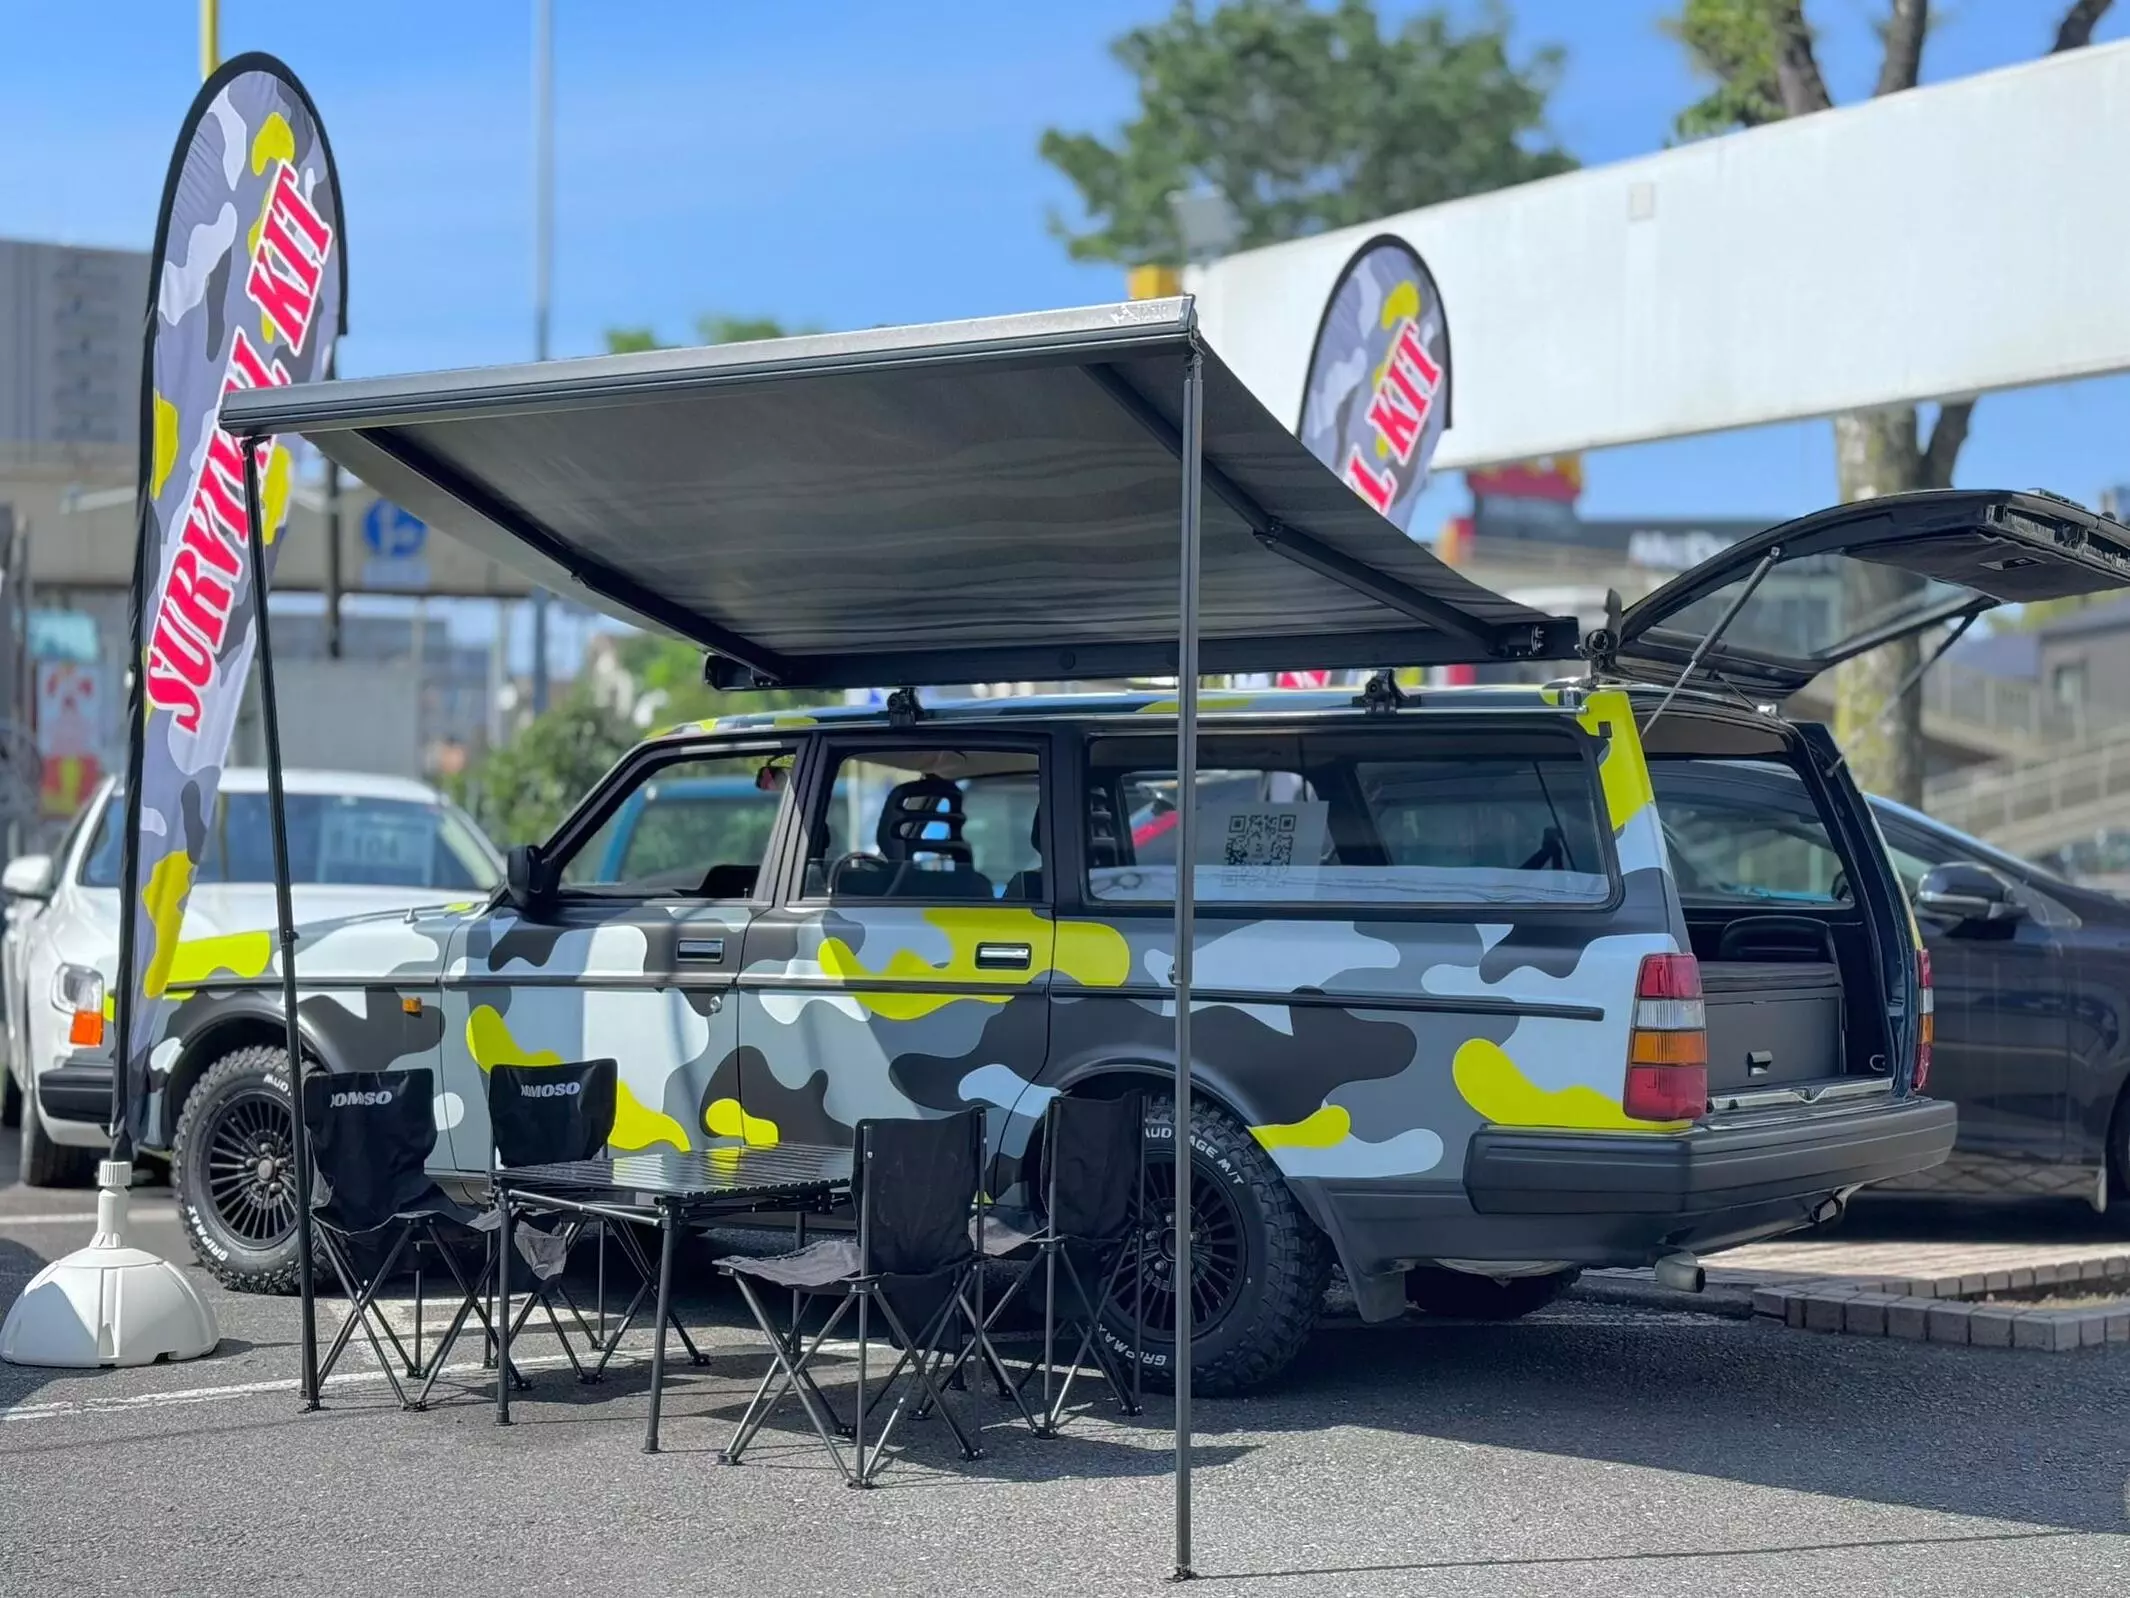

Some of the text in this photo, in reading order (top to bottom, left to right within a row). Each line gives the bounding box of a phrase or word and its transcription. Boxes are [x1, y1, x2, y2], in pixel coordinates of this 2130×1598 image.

[1365, 318, 1443, 466] KIT
[147, 159, 332, 734] SURVIVL KIT
[1189, 1135, 1218, 1159] AGE
[1217, 1158, 1244, 1184] M/T
[187, 1205, 229, 1262] GRIPMAX
